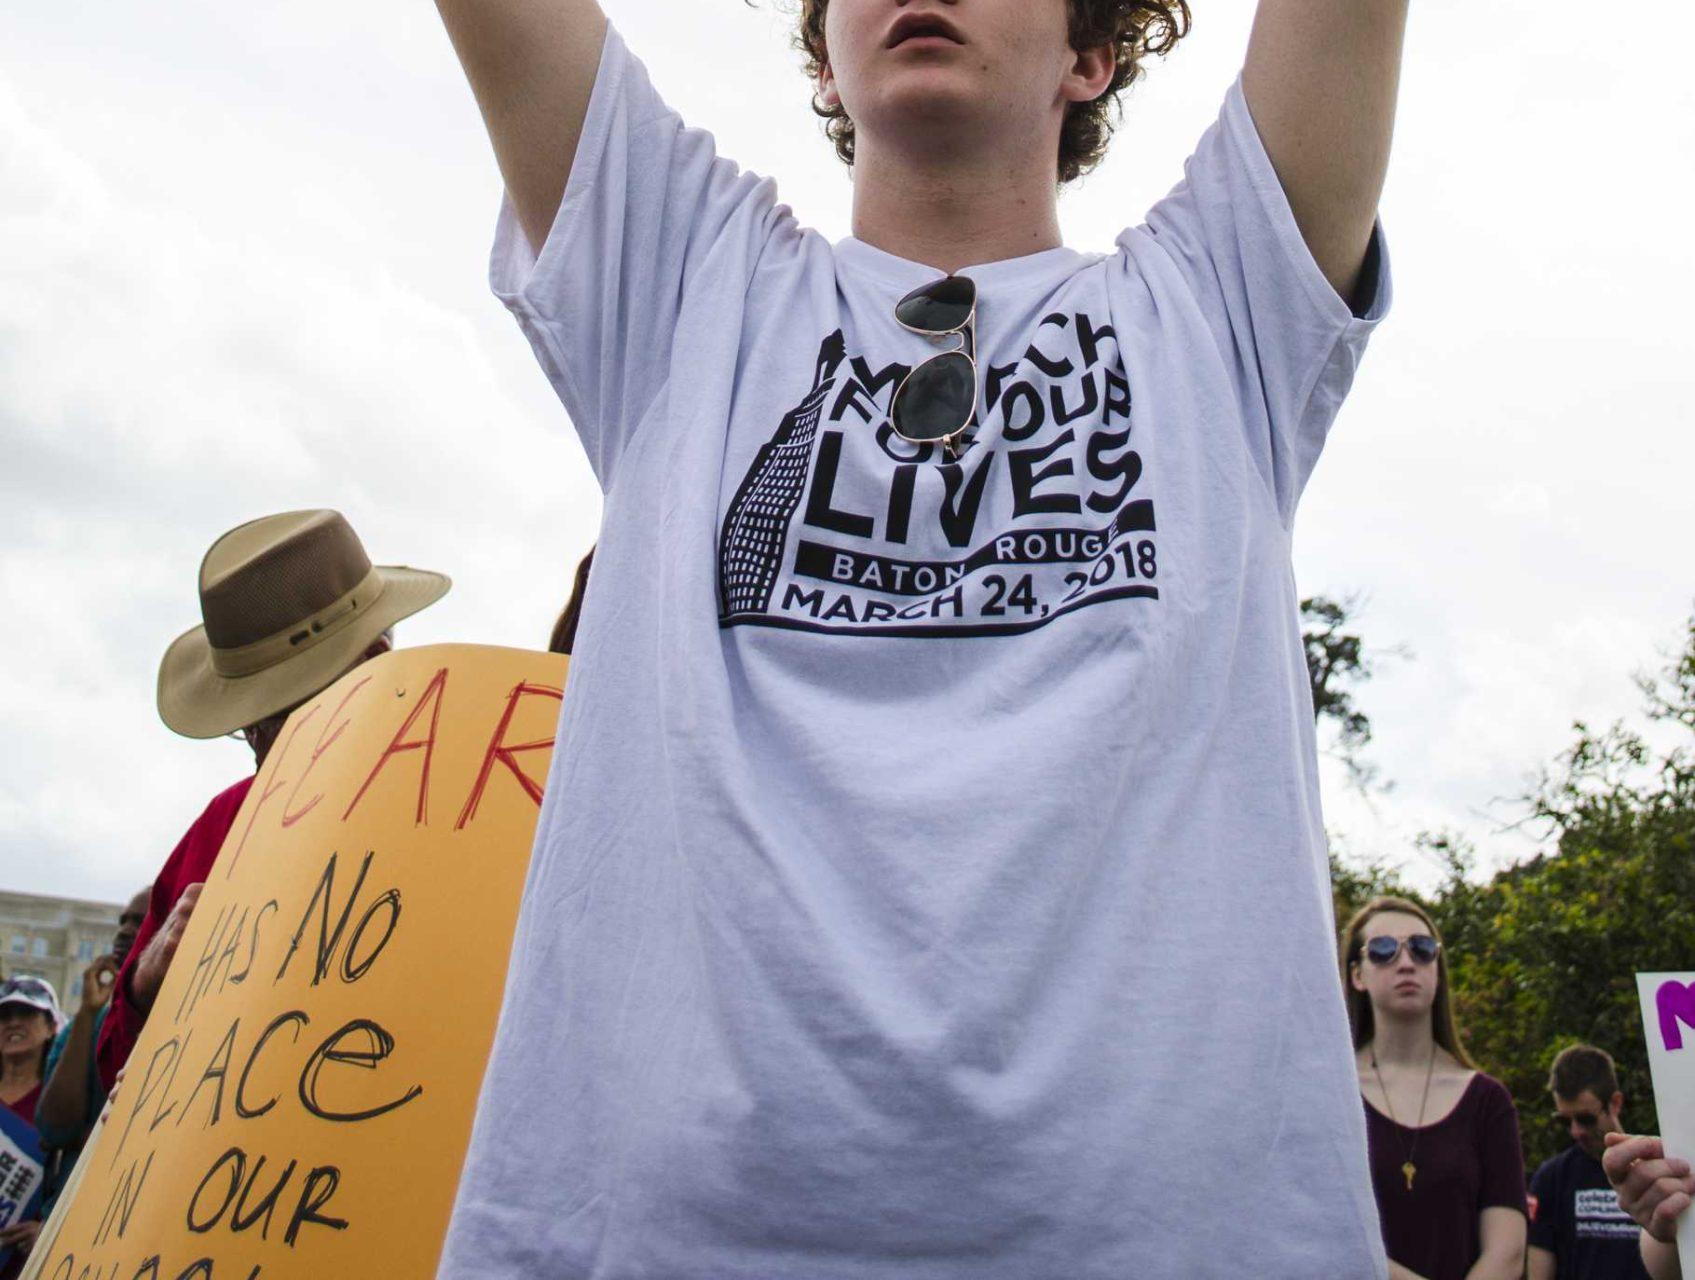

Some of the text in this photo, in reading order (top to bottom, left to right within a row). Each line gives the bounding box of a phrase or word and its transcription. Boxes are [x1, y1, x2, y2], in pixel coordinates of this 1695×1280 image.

[829, 368, 1131, 464] FO OUR
[849, 312, 1126, 417] MCH
[804, 427, 1142, 547] LIVES
[781, 540, 1157, 622] MARCH 24, 2018
[831, 519, 1118, 593] BATON ROUGE
[227, 668, 563, 879] FEAR
[175, 898, 278, 1024] HAS
[92, 1151, 154, 1252] IN
[187, 1147, 349, 1248] OUR
